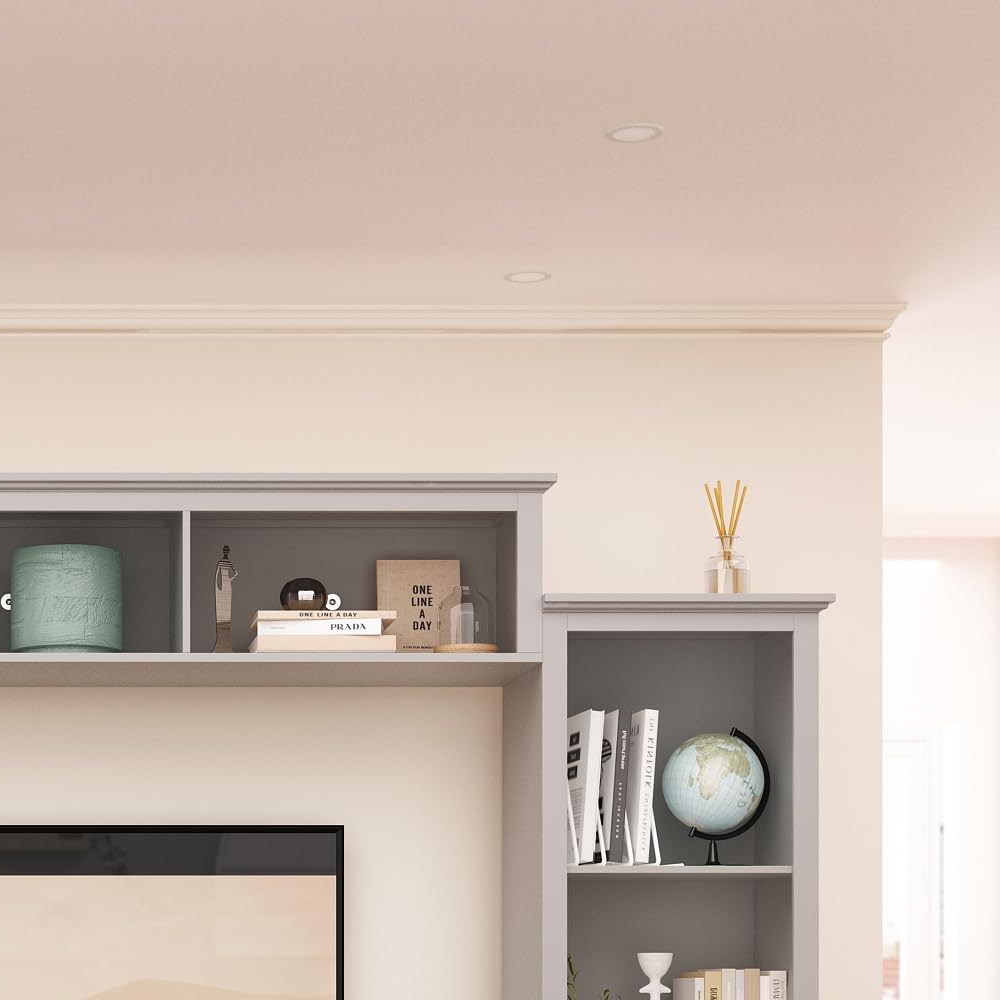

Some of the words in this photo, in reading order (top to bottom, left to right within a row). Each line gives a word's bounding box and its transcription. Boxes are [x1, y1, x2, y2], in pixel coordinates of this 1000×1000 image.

[412, 585, 432, 594] ONE
[411, 597, 434, 606] LINE
[418, 609, 426, 618] A
[330, 623, 366, 631] PRADA
[412, 621, 432, 631] DAY
